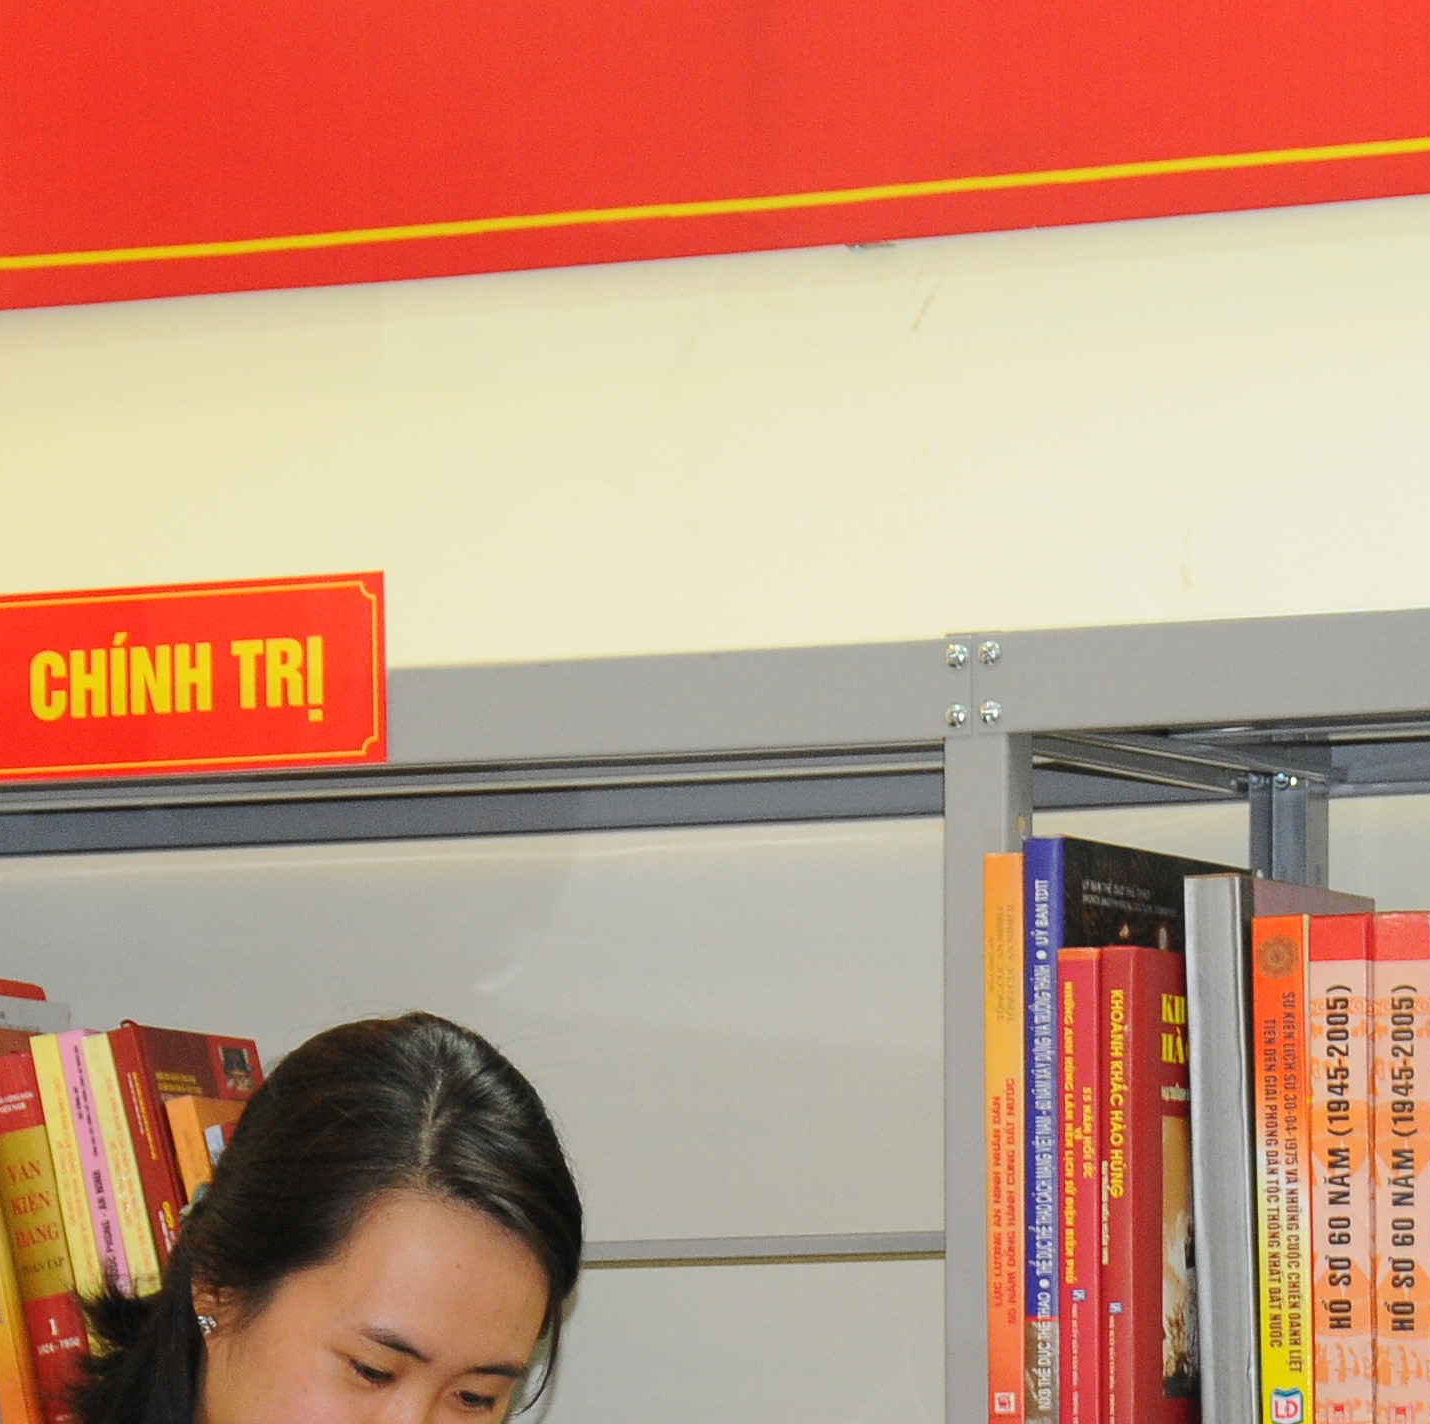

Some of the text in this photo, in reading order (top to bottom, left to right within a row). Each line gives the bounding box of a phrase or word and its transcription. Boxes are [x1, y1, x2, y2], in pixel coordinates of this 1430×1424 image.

[28, 632, 326, 723] CHÍNH TRỊ
[1110, 989, 1125, 1198] KHOẢNH KHẮC HÀO HÙNG
[1161, 1027, 1189, 1064] HÀ
[1282, 1093, 1299, 1166] 30-04-1975
[1325, 983, 1352, 1329] HỒ SƠ 60 NĂM (1945-2005)
[1388, 984, 1417, 1331] HỒ SƠ 60 NĂM (1945-2005)
